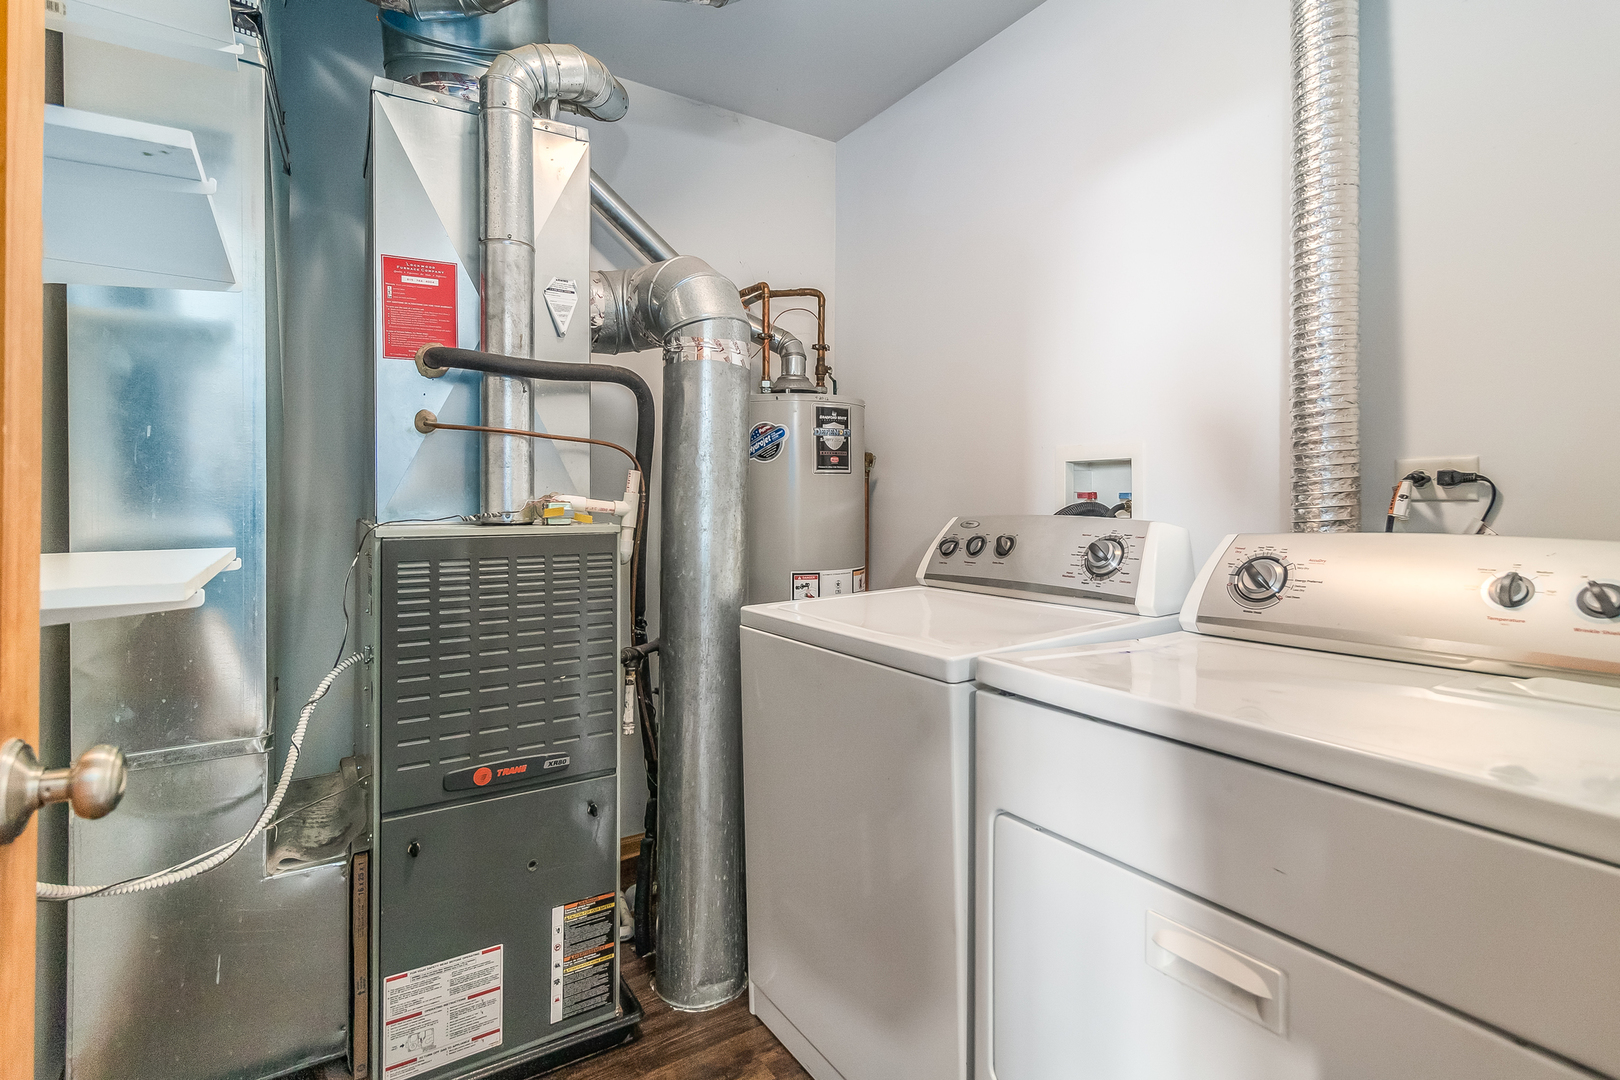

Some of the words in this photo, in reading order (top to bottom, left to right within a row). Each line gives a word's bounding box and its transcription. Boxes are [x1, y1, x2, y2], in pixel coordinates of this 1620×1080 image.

[813, 428, 851, 437] DEFENDER
[1486, 615, 1526, 623] Temperature
[496, 764, 528, 778] TRANE
[547, 758, 567, 768] XR80
[358, 872, 365, 881] 25
[358, 887, 365, 896] 16
